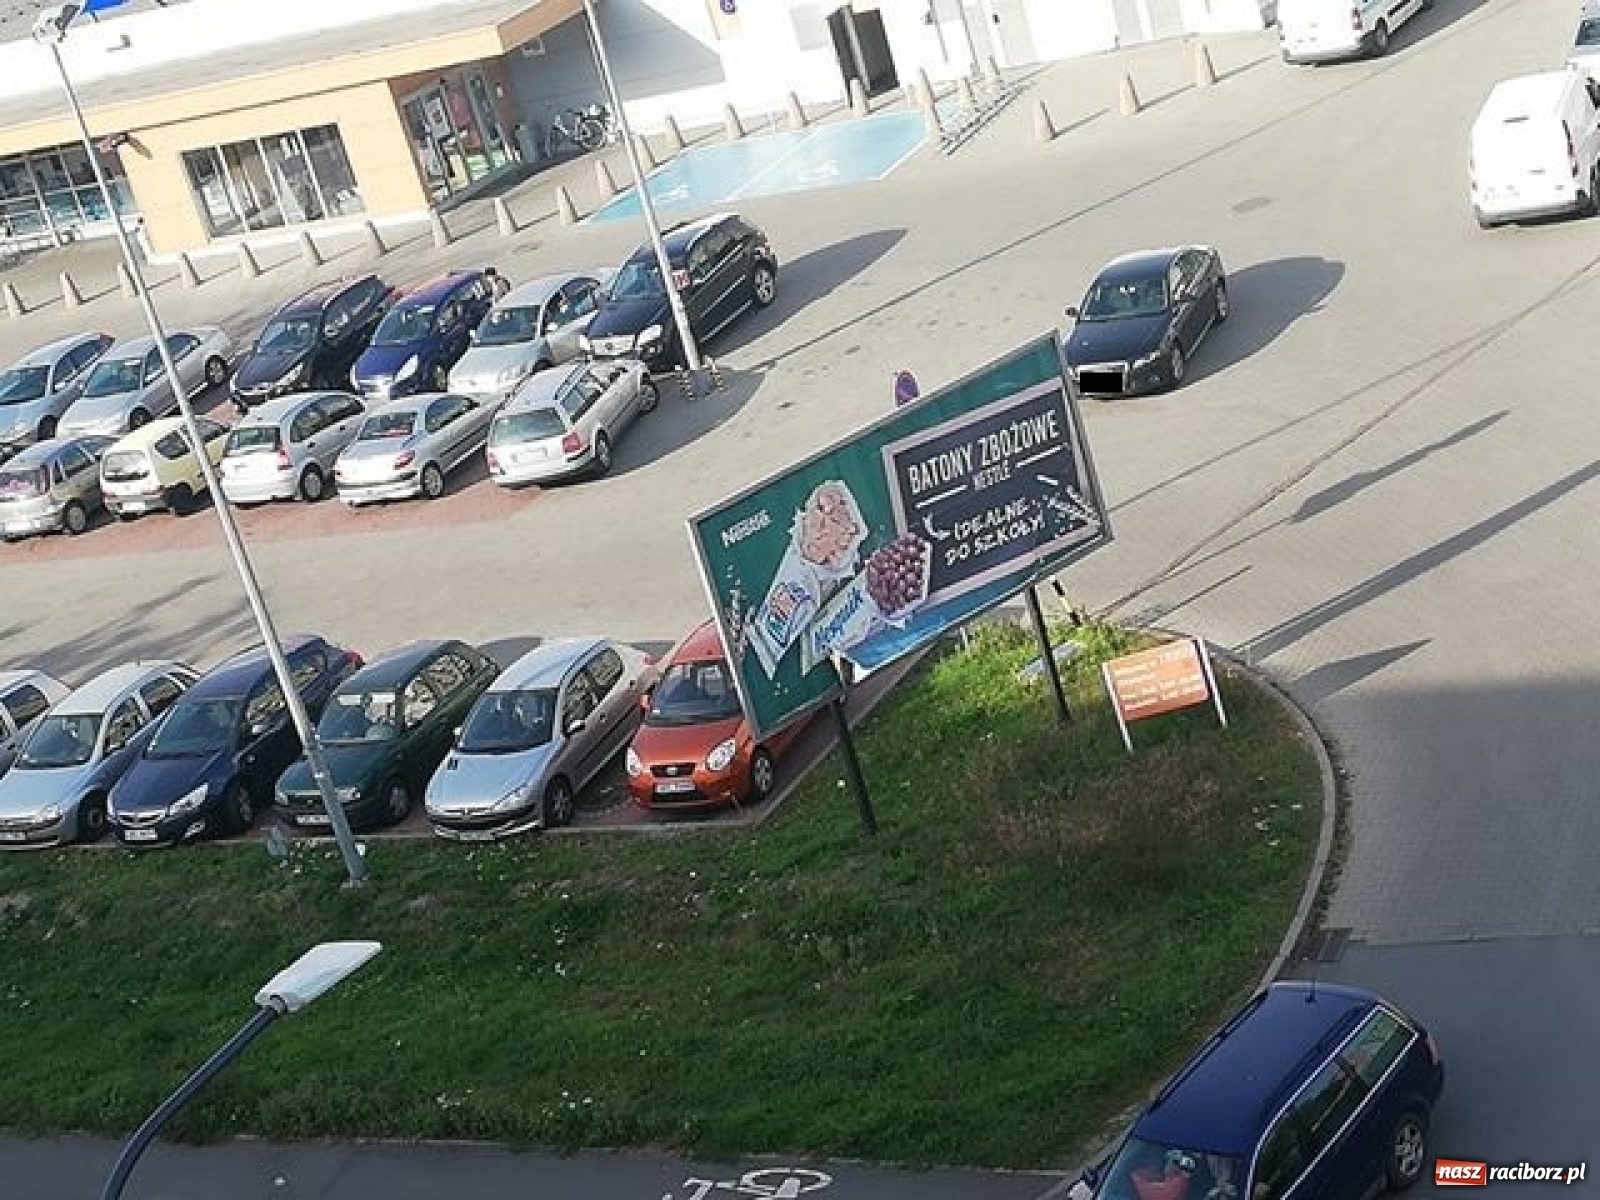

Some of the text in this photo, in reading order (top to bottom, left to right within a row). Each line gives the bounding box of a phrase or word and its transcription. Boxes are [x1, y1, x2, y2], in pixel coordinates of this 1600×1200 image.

[909, 409, 1060, 495] BATONY ZBOŻOWE
[954, 498, 1028, 540] IDEALNE
[945, 543, 971, 566] DO
